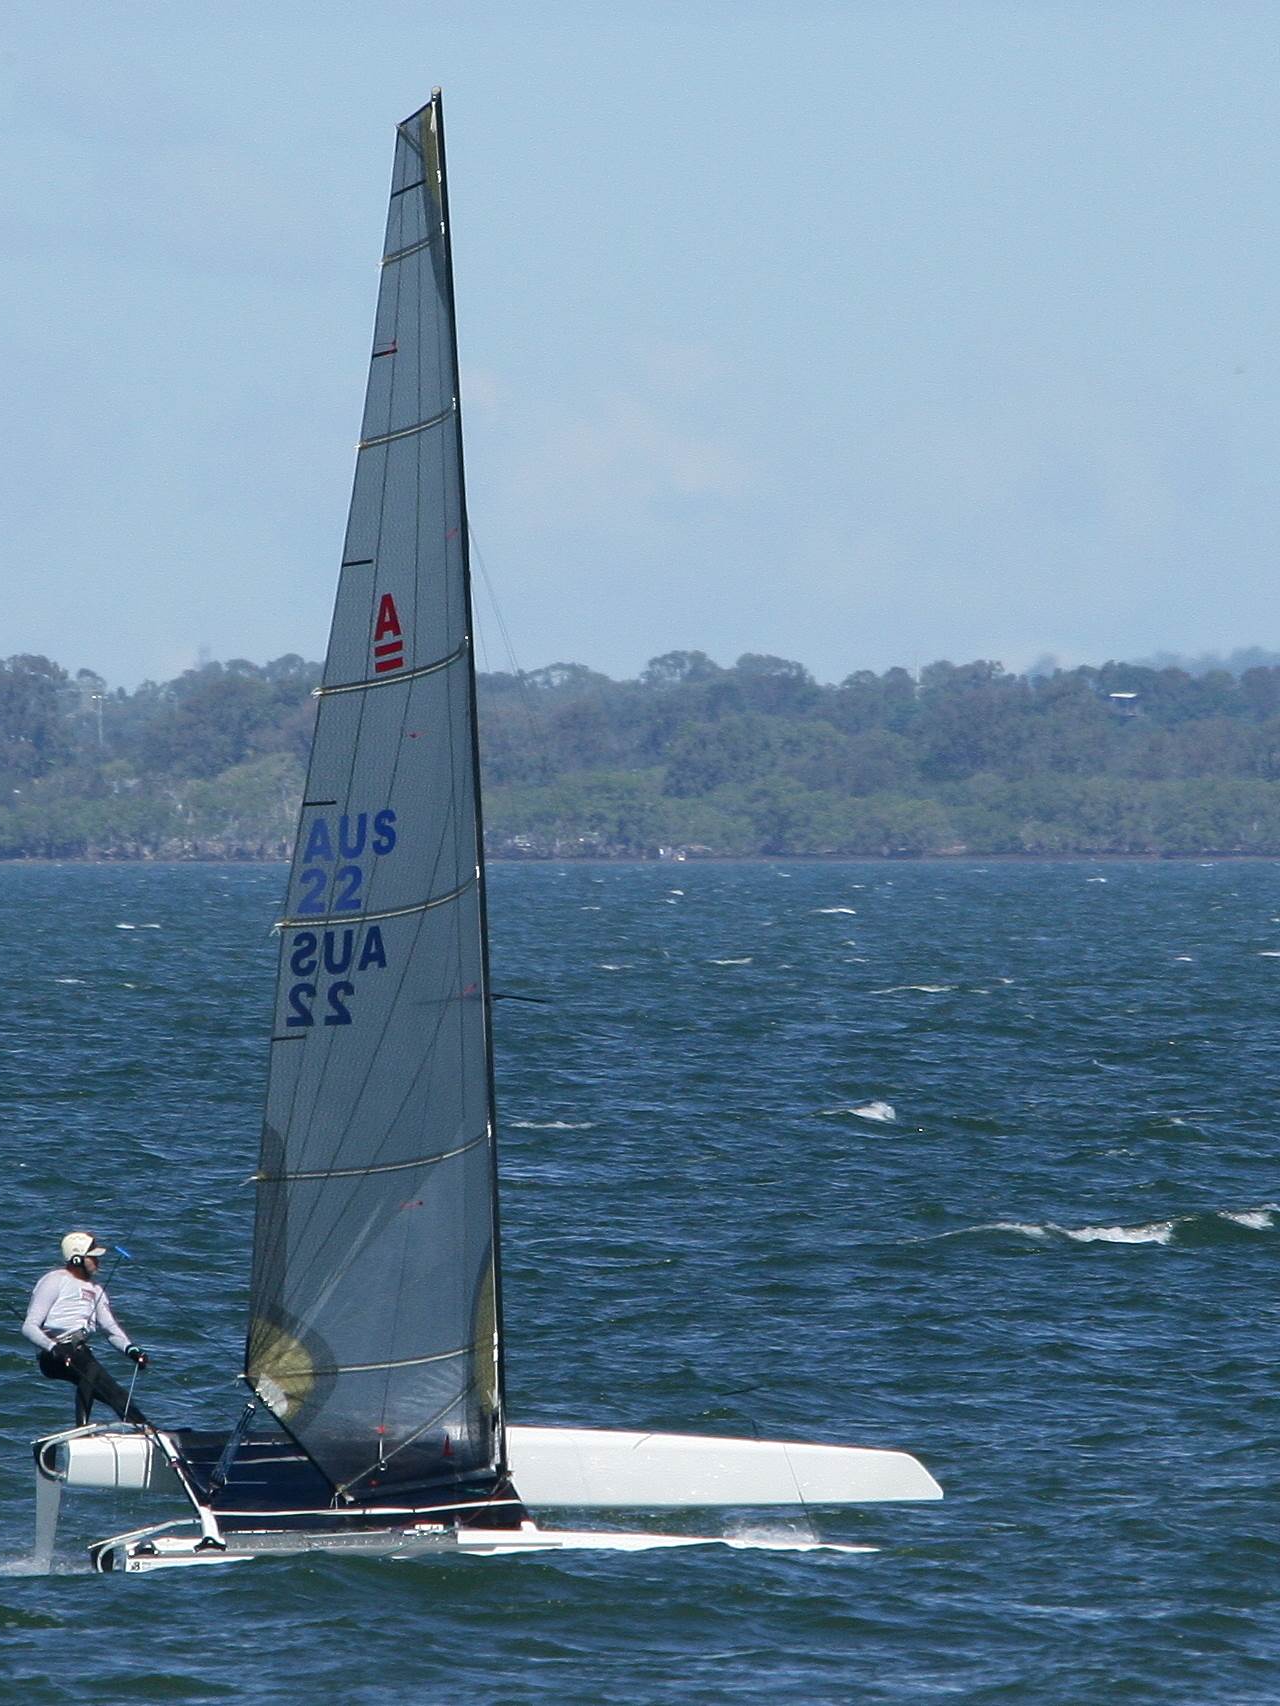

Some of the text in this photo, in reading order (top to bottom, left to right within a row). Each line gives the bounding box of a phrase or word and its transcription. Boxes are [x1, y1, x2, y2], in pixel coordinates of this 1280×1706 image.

[374, 592, 402, 641] A
[303, 809, 397, 864] AUS
[297, 865, 363, 914] 22
